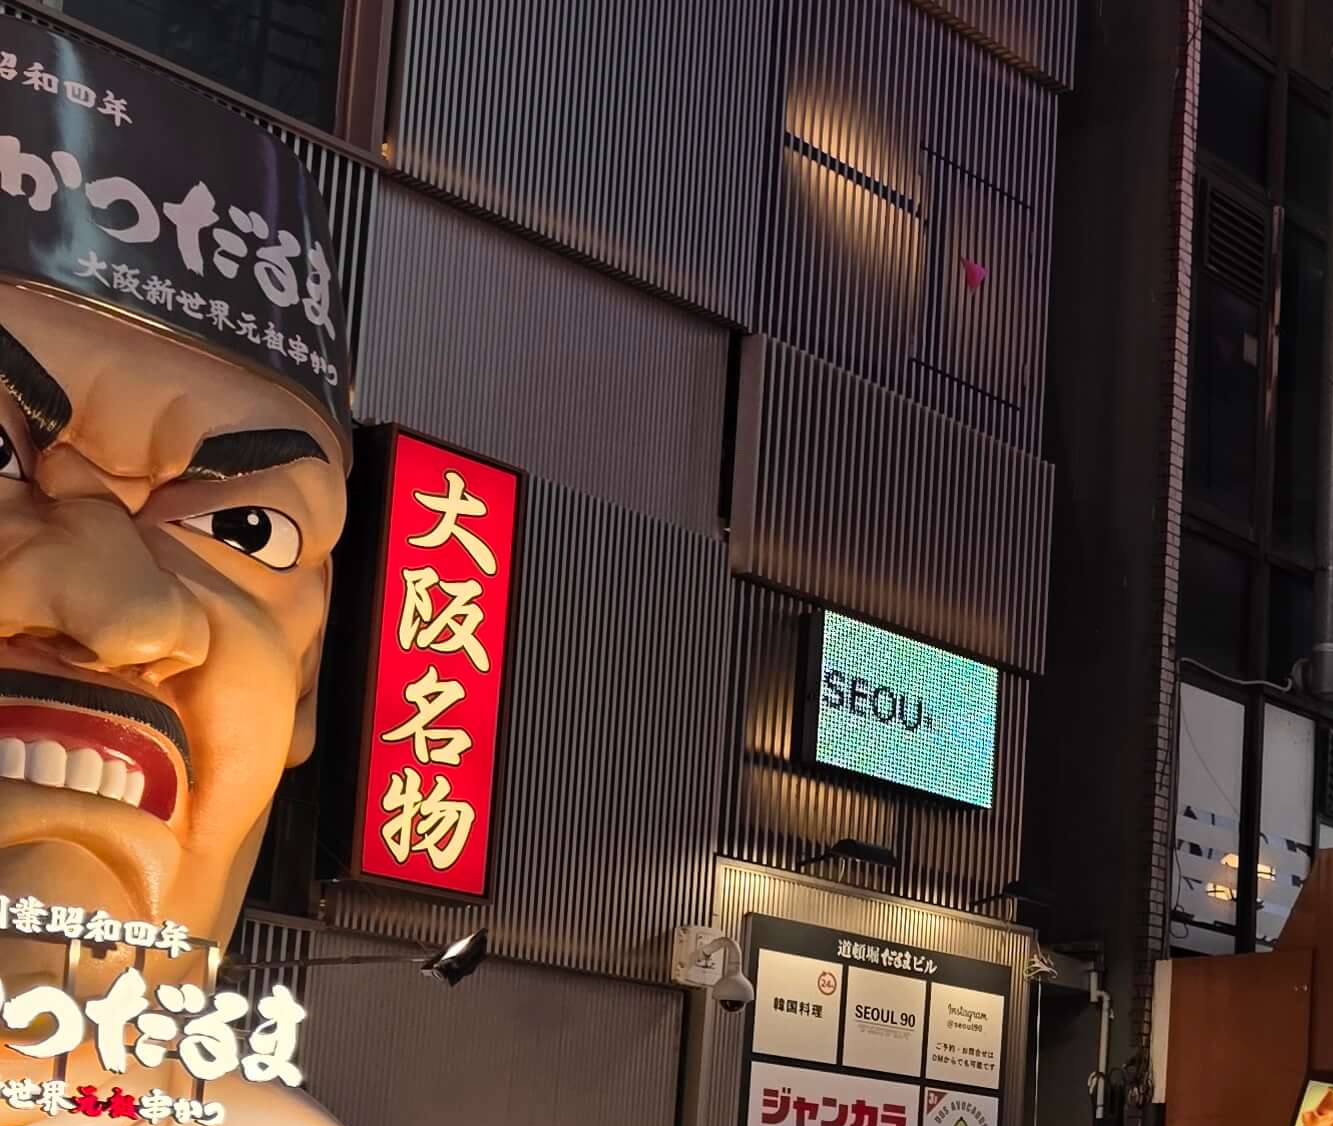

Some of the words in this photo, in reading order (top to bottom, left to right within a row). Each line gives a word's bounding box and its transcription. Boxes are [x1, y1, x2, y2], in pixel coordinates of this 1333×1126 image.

[379, 469, 498, 871] 大阪名物
[773, 996, 825, 1019] 韓国料理
[854, 1003, 898, 1026] SEOUL
[900, 1011, 917, 1029] 90
[947, 1002, 989, 1023] Instagram
[0, 966, 307, 1088] つだるま
